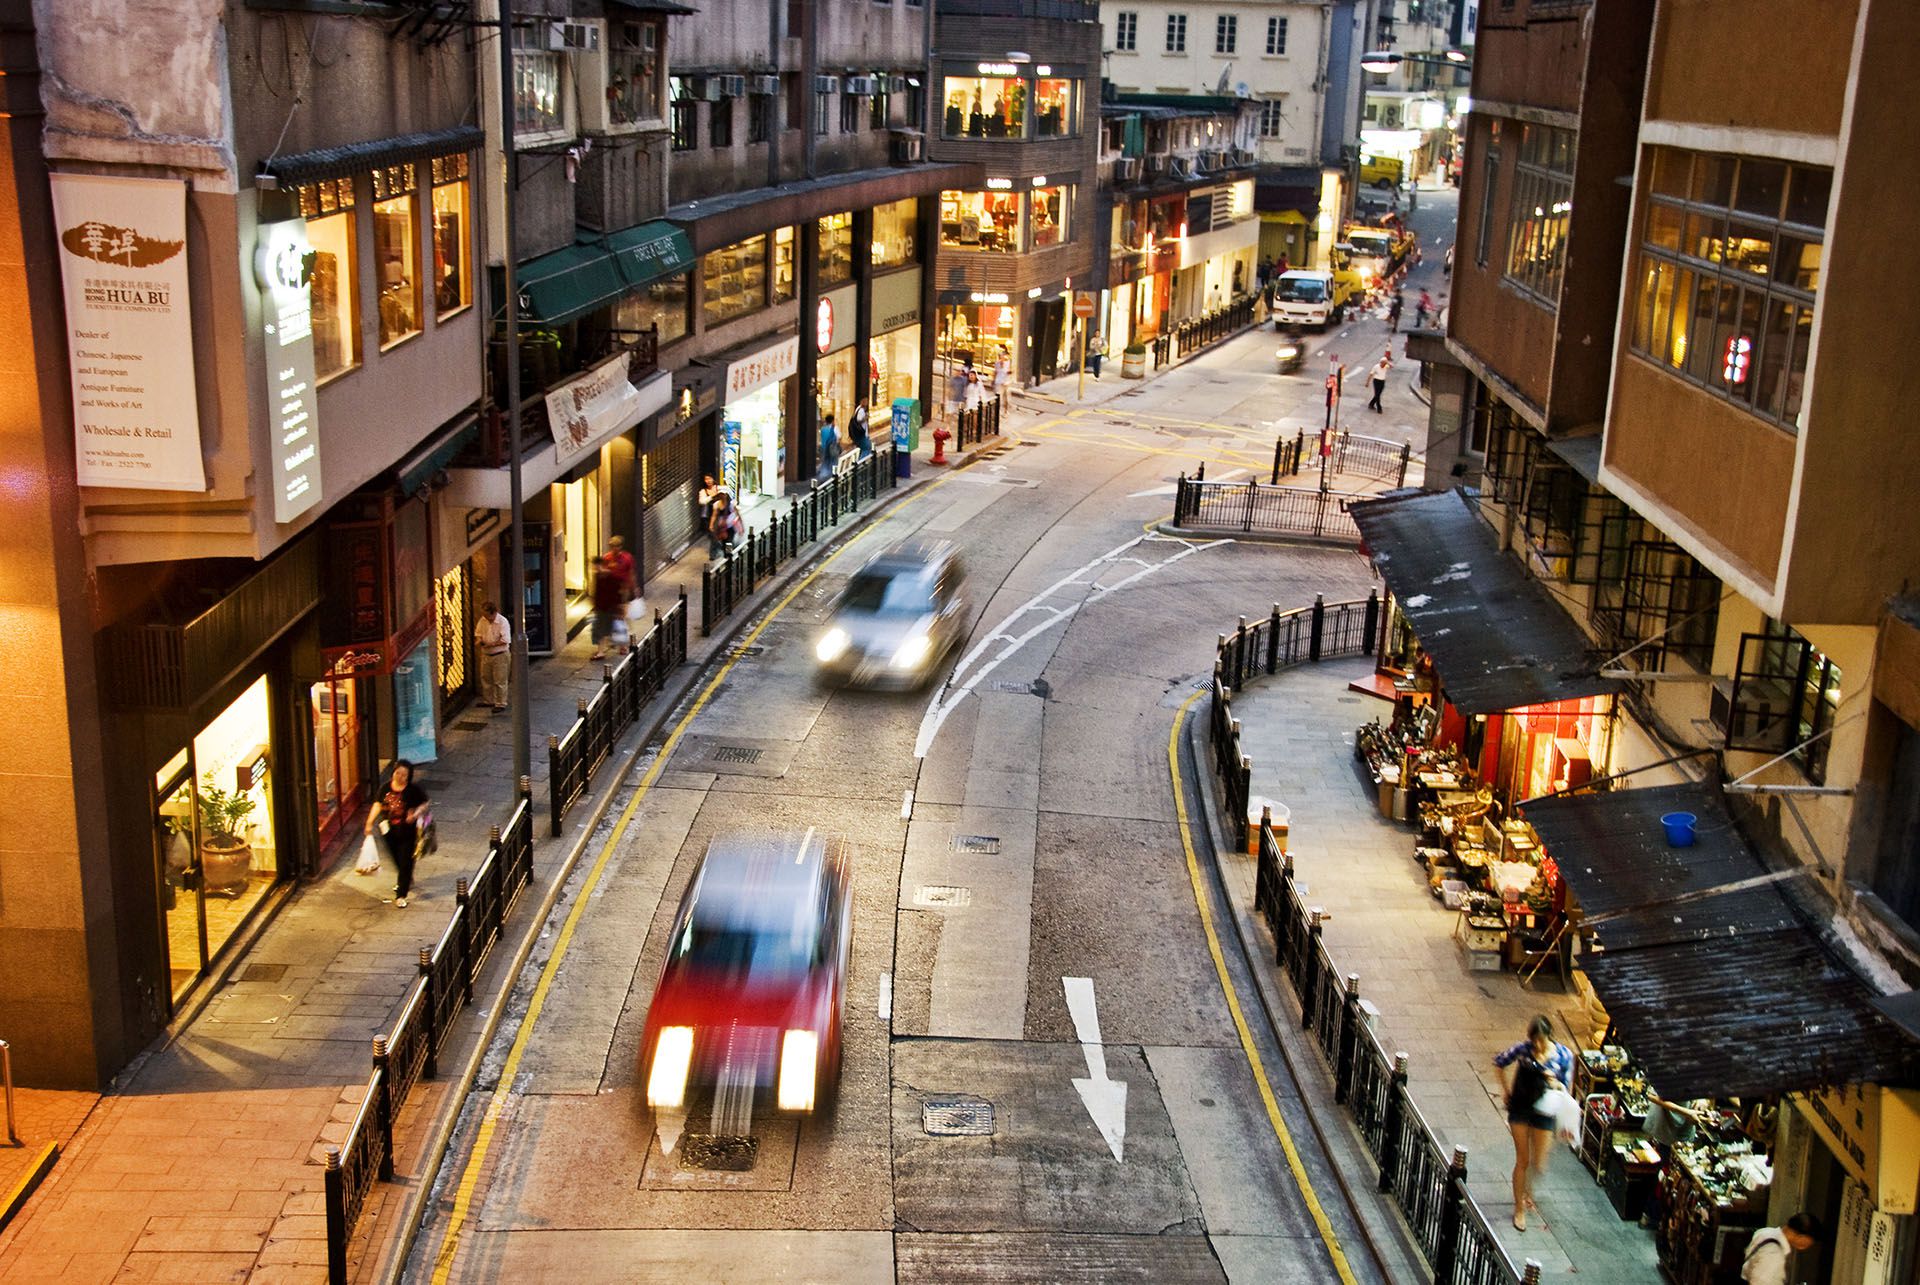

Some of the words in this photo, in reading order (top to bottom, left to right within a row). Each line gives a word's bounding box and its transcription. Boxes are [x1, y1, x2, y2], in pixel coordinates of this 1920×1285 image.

[85, 288, 105, 296] HONG
[106, 289, 144, 304] HUA
[147, 291, 169, 305] BU
[86, 303, 122, 311] FURNITURE
[124, 305, 156, 313] COMPANY
[75, 330, 99, 339] Dealer
[110, 352, 143, 361] Japanese
[78, 367, 92, 375] and
[93, 367, 128, 377] European
[80, 383, 109, 393] Antique
[110, 384, 144, 394] Furniture
[81, 399, 94, 407] and
[96, 399, 119, 408] Works
[83, 424, 131, 437] Wholesale
[133, 427, 143, 438] &
[145, 427, 172, 438] Retail
